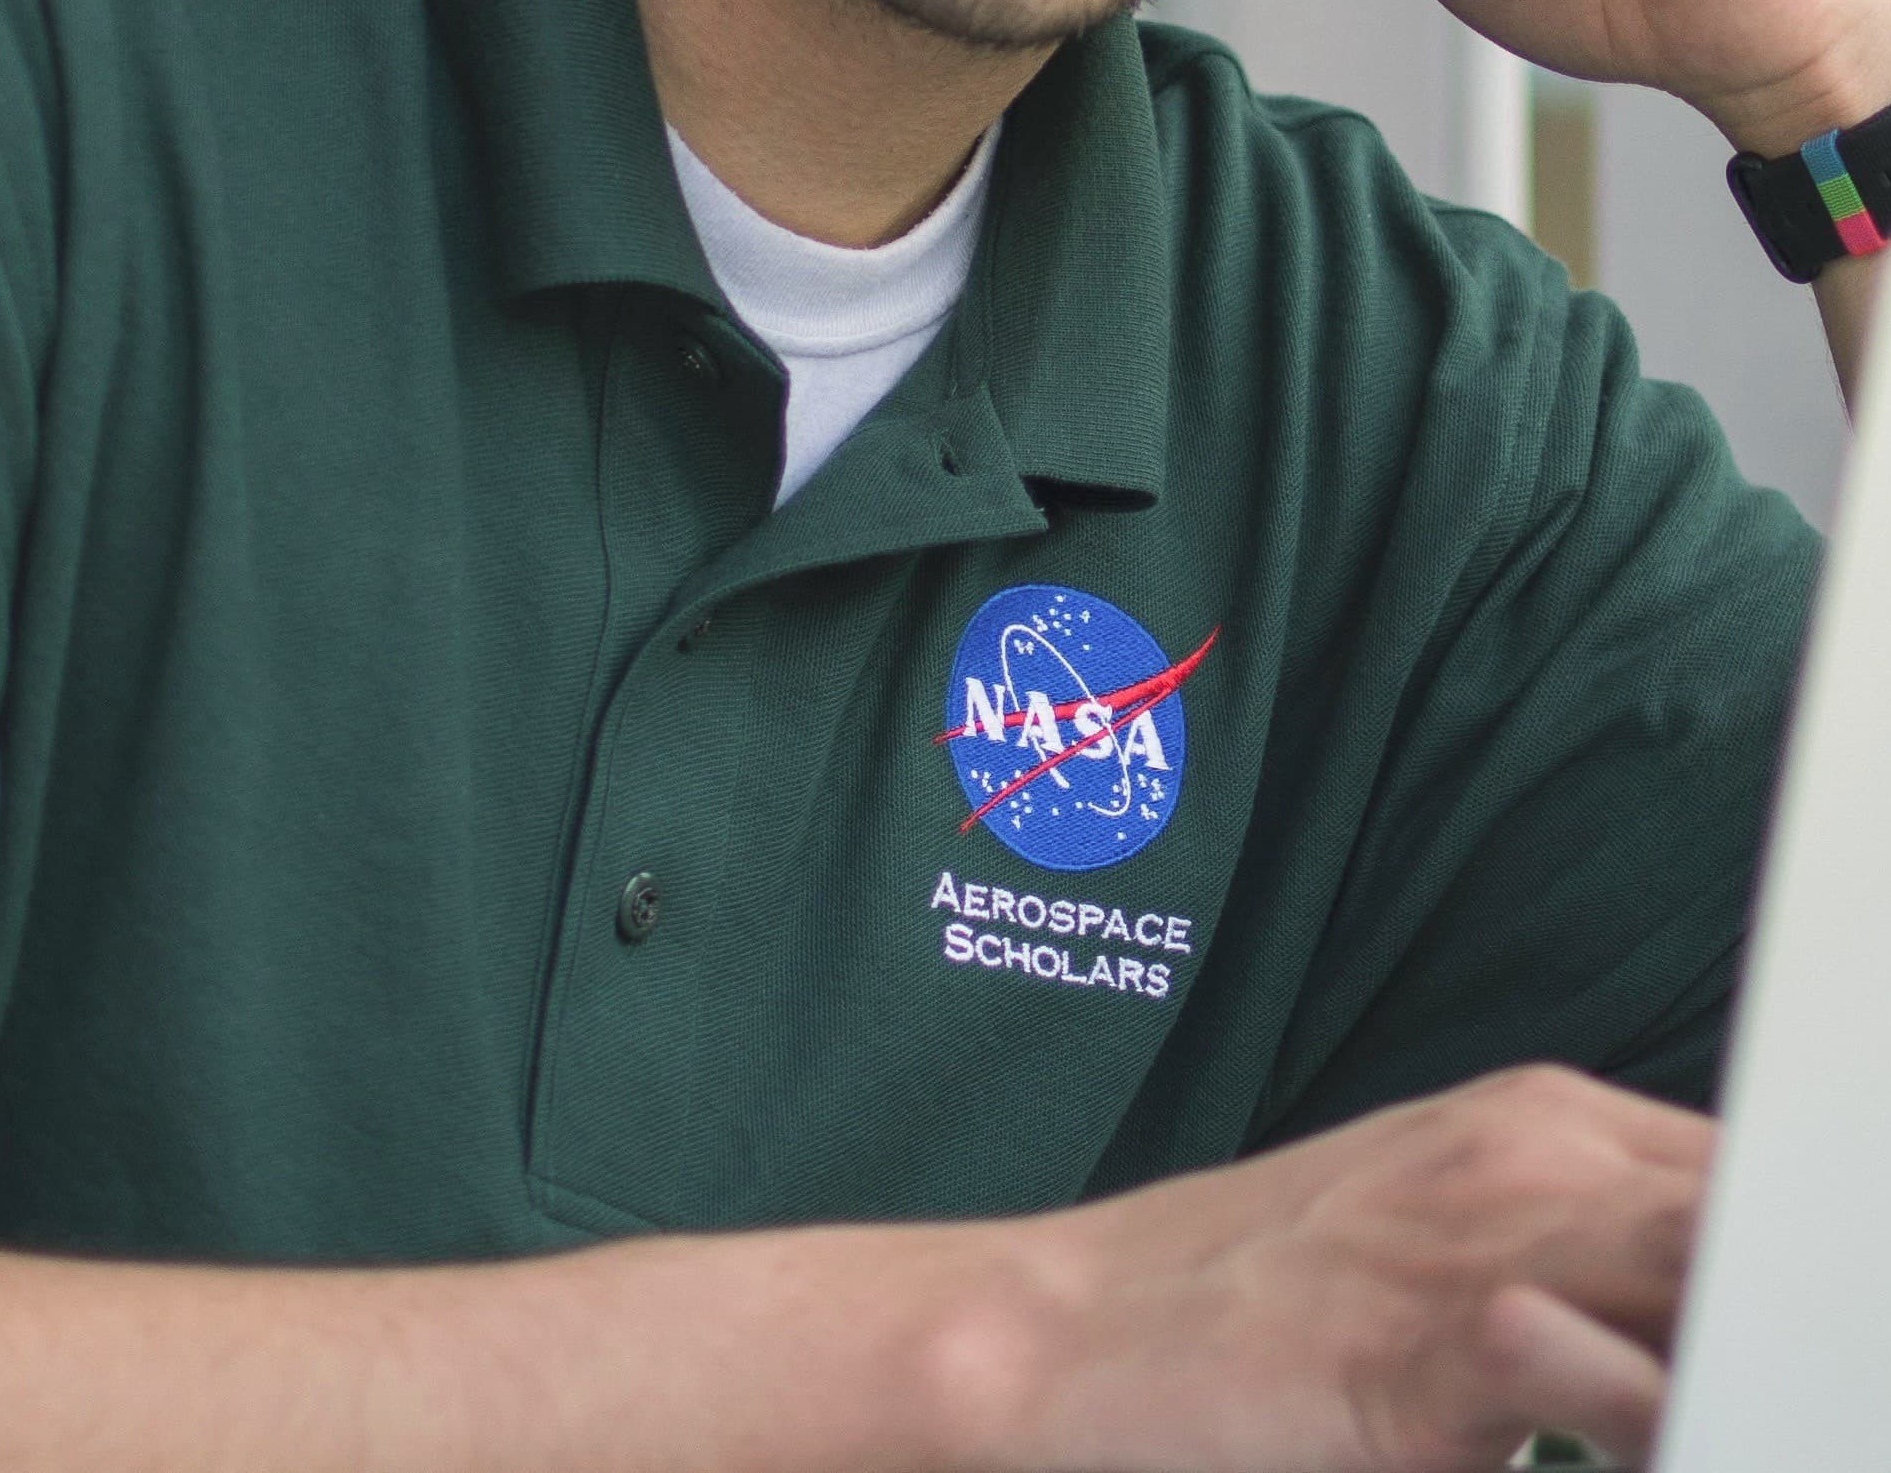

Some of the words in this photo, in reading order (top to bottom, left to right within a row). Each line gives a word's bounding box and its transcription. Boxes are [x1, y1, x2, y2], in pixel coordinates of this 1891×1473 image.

[964, 677, 1170, 770] NASA
[930, 872, 1192, 954] AEROSPACE
[943, 924, 1171, 998] SCHOLARS
